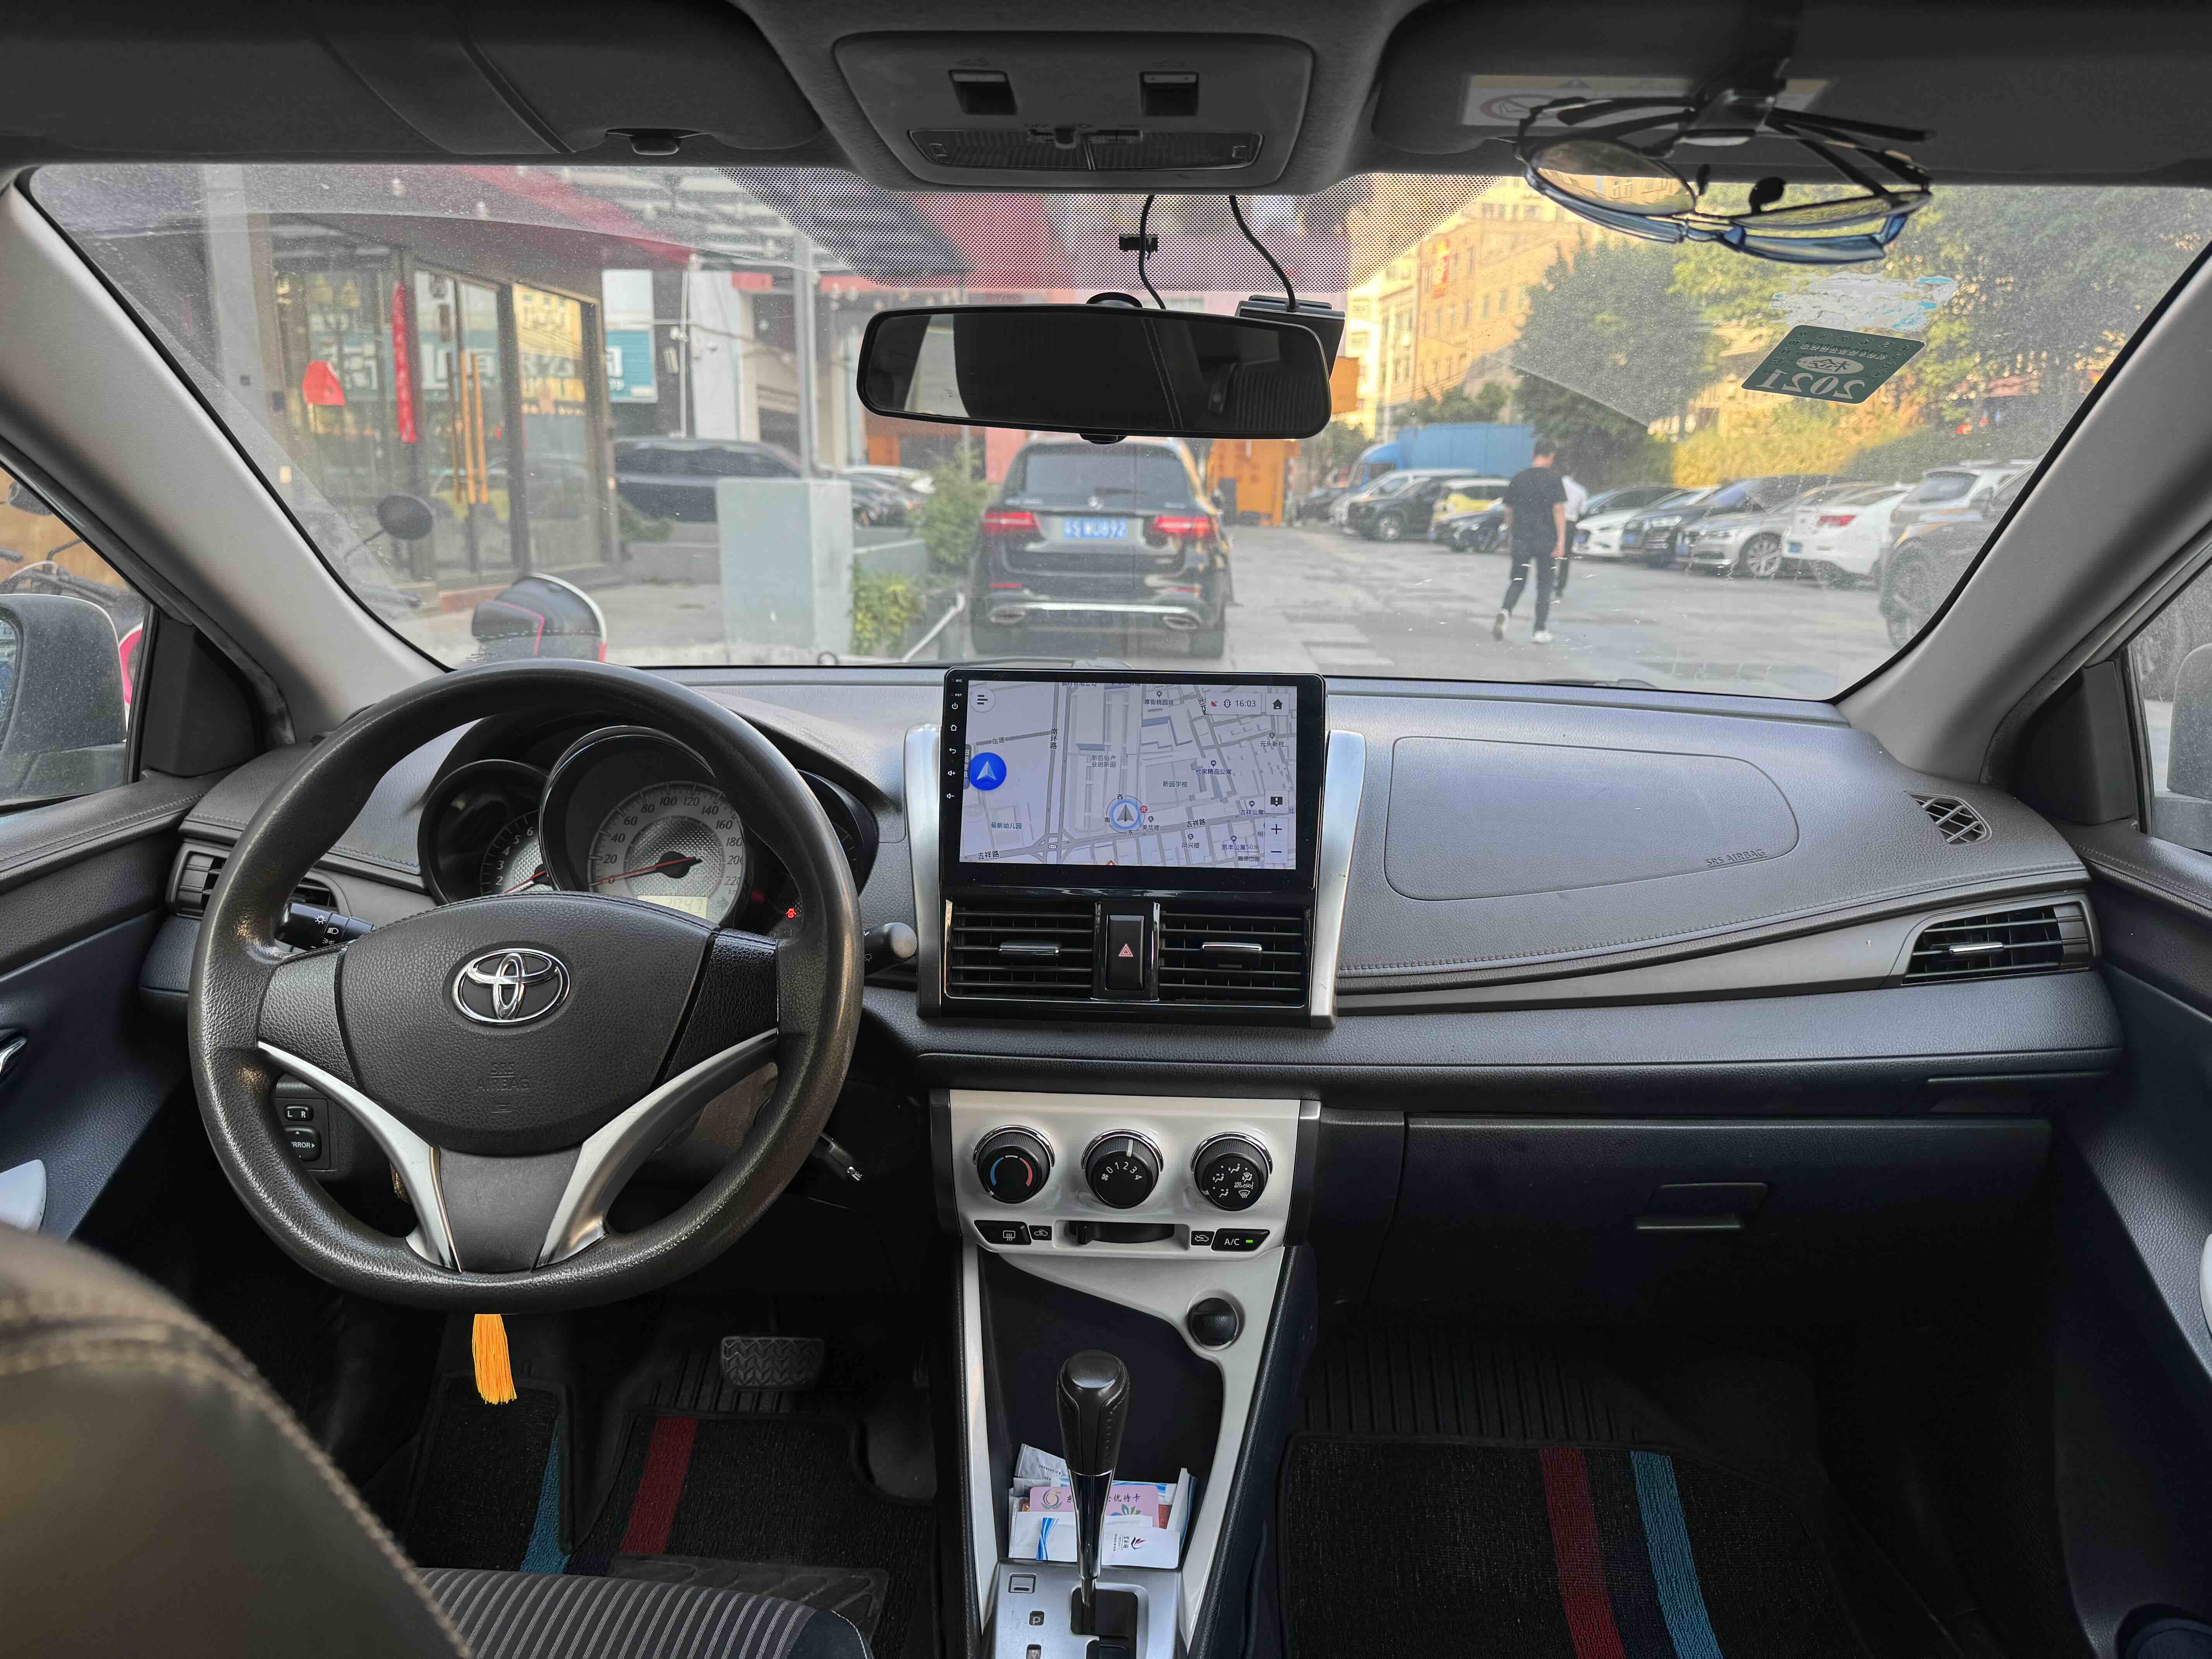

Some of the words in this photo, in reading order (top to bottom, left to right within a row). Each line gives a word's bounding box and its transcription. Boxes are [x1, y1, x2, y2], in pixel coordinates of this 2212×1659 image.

[660, 796, 677, 806] 100
[683, 797, 700, 806] 120
[641, 804, 655, 813] 80
[702, 805, 719, 815] 140
[623, 816, 637, 826] 60
[715, 820, 733, 829] 160
[1186, 818, 1206, 828] 吉祥路
[527, 827, 533, 836] 6
[513, 835, 521, 845] 5
[610, 833, 625, 842] 40
[725, 838, 743, 847] 180
[502, 846, 509, 856] 4
[978, 850, 1000, 860] 吉祥路
[603, 855, 617, 864] 20
[1705, 856, 1724, 866] SRS
[1727, 848, 1766, 864] AIRBAG
[497, 860, 504, 870] 3
[495, 876, 503, 885] 2
[491, 1062, 515, 1074] SRS
[476, 1078, 530, 1091] AIRBAG
[1123, 1162, 1129, 1170] 2
[1032, 1616, 1041, 1625] P
